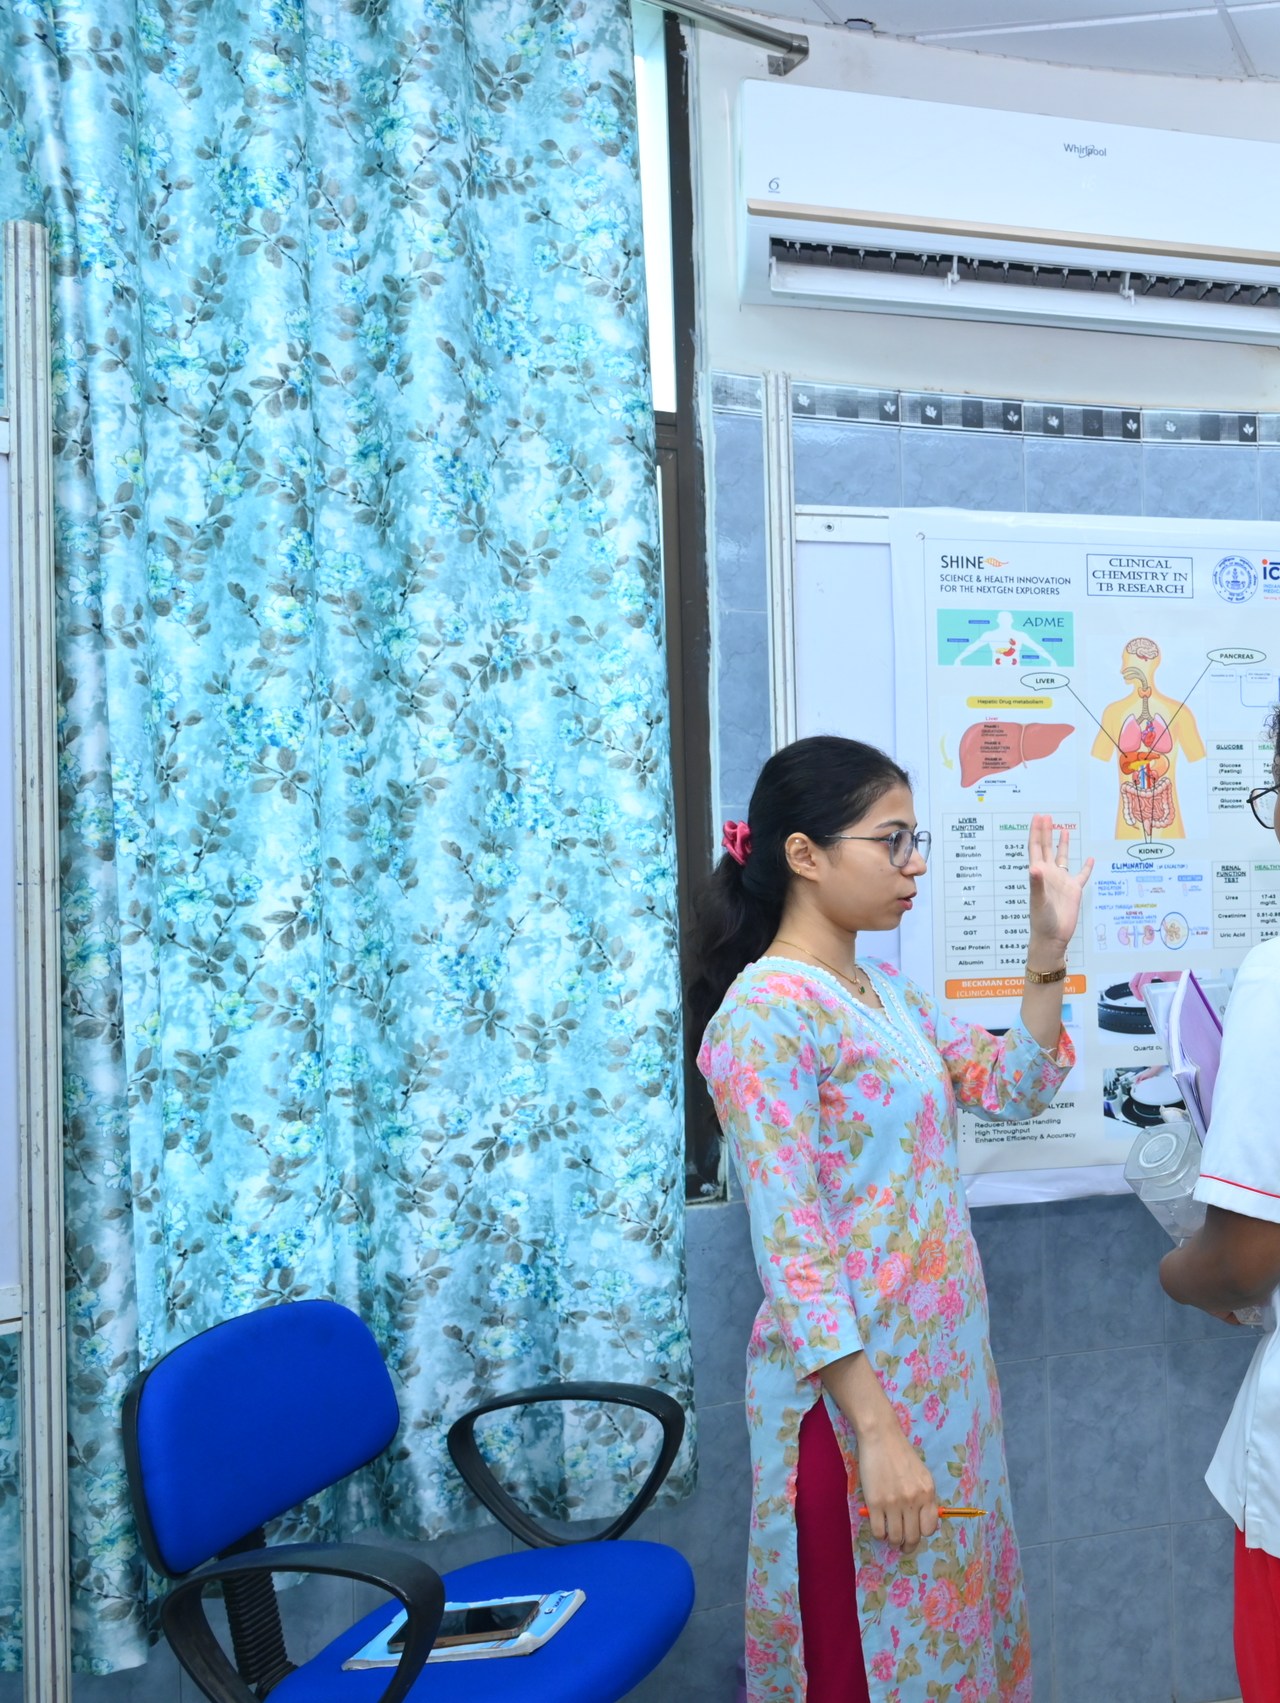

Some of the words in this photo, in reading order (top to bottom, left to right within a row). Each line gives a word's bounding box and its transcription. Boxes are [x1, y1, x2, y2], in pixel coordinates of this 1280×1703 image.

[1063, 143, 1107, 158] Whirlpool
[941, 555, 984, 570] SHINE
[1109, 558, 1172, 569] CLINICAL
[940, 574, 973, 583] SCIENCE
[976, 575, 982, 583] &
[984, 575, 1014, 584] HEALTH
[1016, 576, 1071, 585] INNOVATION
[1092, 570, 1169, 581] CHEMISTRY
[1173, 572, 1188, 581] IN
[940, 584, 957, 593] FOR
[960, 585, 974, 593] THE
[976, 586, 1014, 594] NEXTGEN
[1016, 587, 1060, 595] EXPLORERS
[1096, 582, 1114, 592] TB
[1117, 583, 1185, 594] RESEARCH
[1023, 617, 1064, 628] ADME
[1111, 862, 1154, 870] ELIMINATION
[1032, 1117, 1062, 1125] Handling
[992, 1127, 1031, 1136] Throughput
[1046, 1131, 1076, 1139] Accuracy
